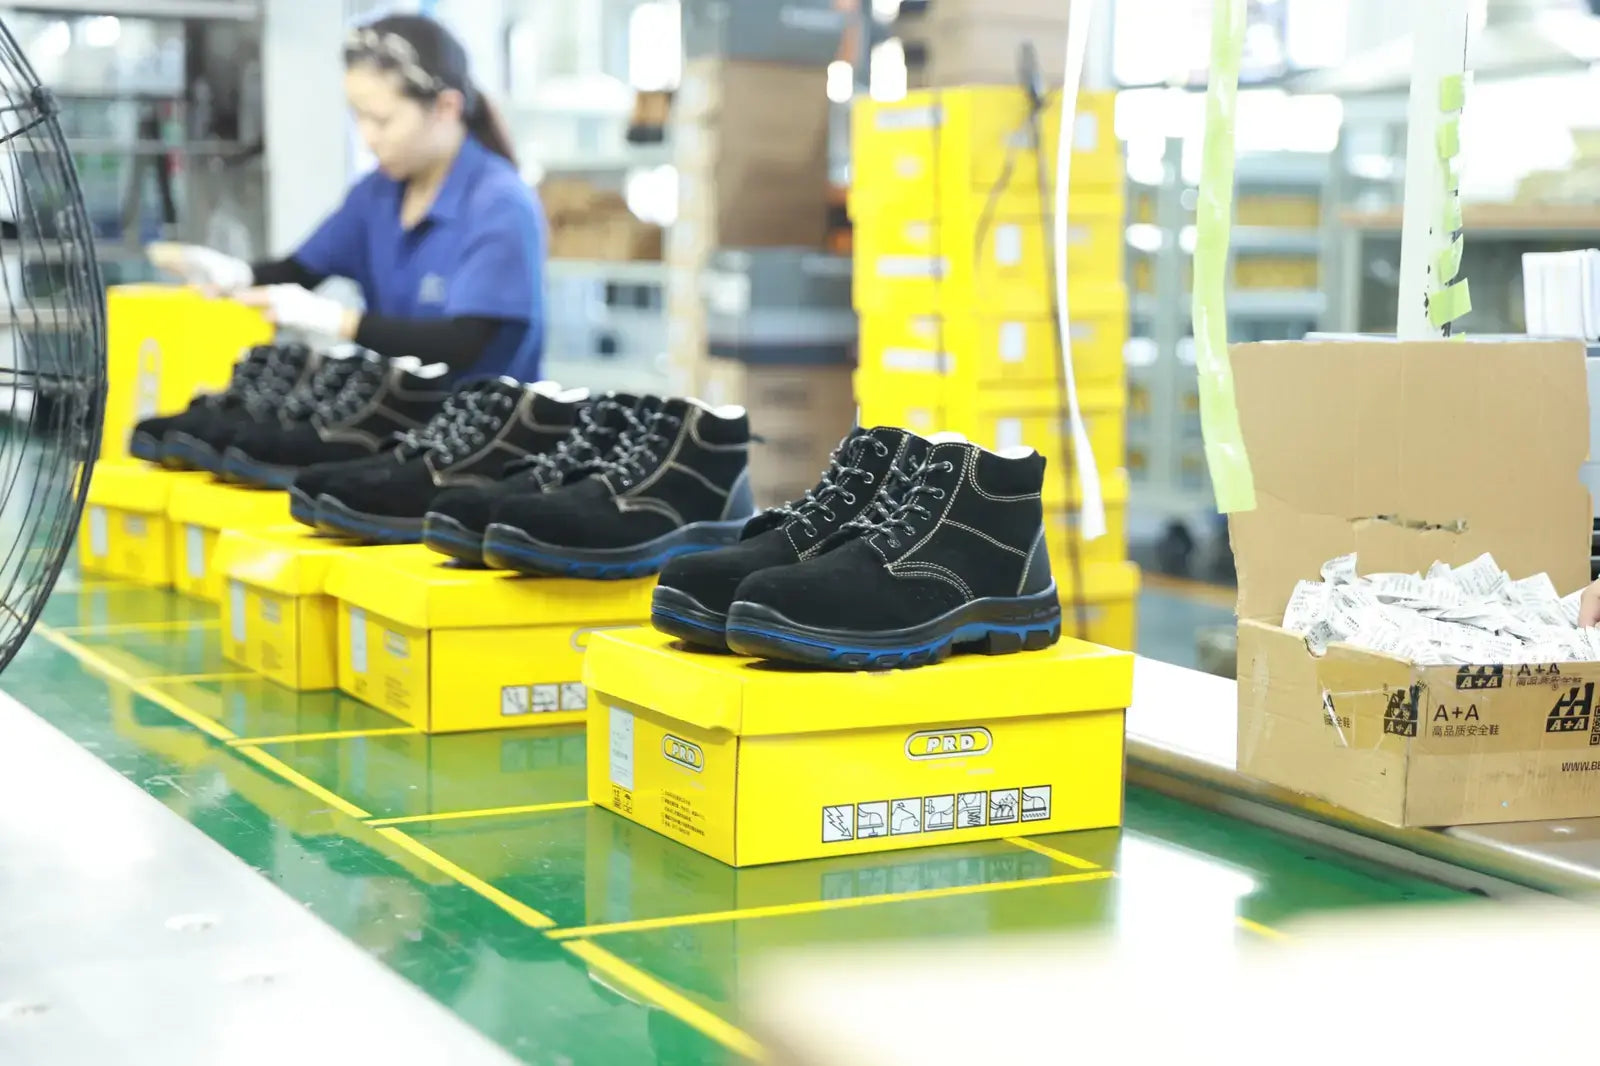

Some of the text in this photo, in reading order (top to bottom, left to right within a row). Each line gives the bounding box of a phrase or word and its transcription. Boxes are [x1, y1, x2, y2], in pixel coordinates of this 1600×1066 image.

[1517, 663, 1560, 676] A+A
[1460, 676, 1499, 688] A+A
[1433, 704, 1479, 721] A+A
[1386, 721, 1413, 735] A+A
[1432, 724, 1500, 737] 高品质安全鞋
[1549, 718, 1585, 731] A+A
[926, 734, 975, 753] PRD
[672, 742, 696, 764] PRD
